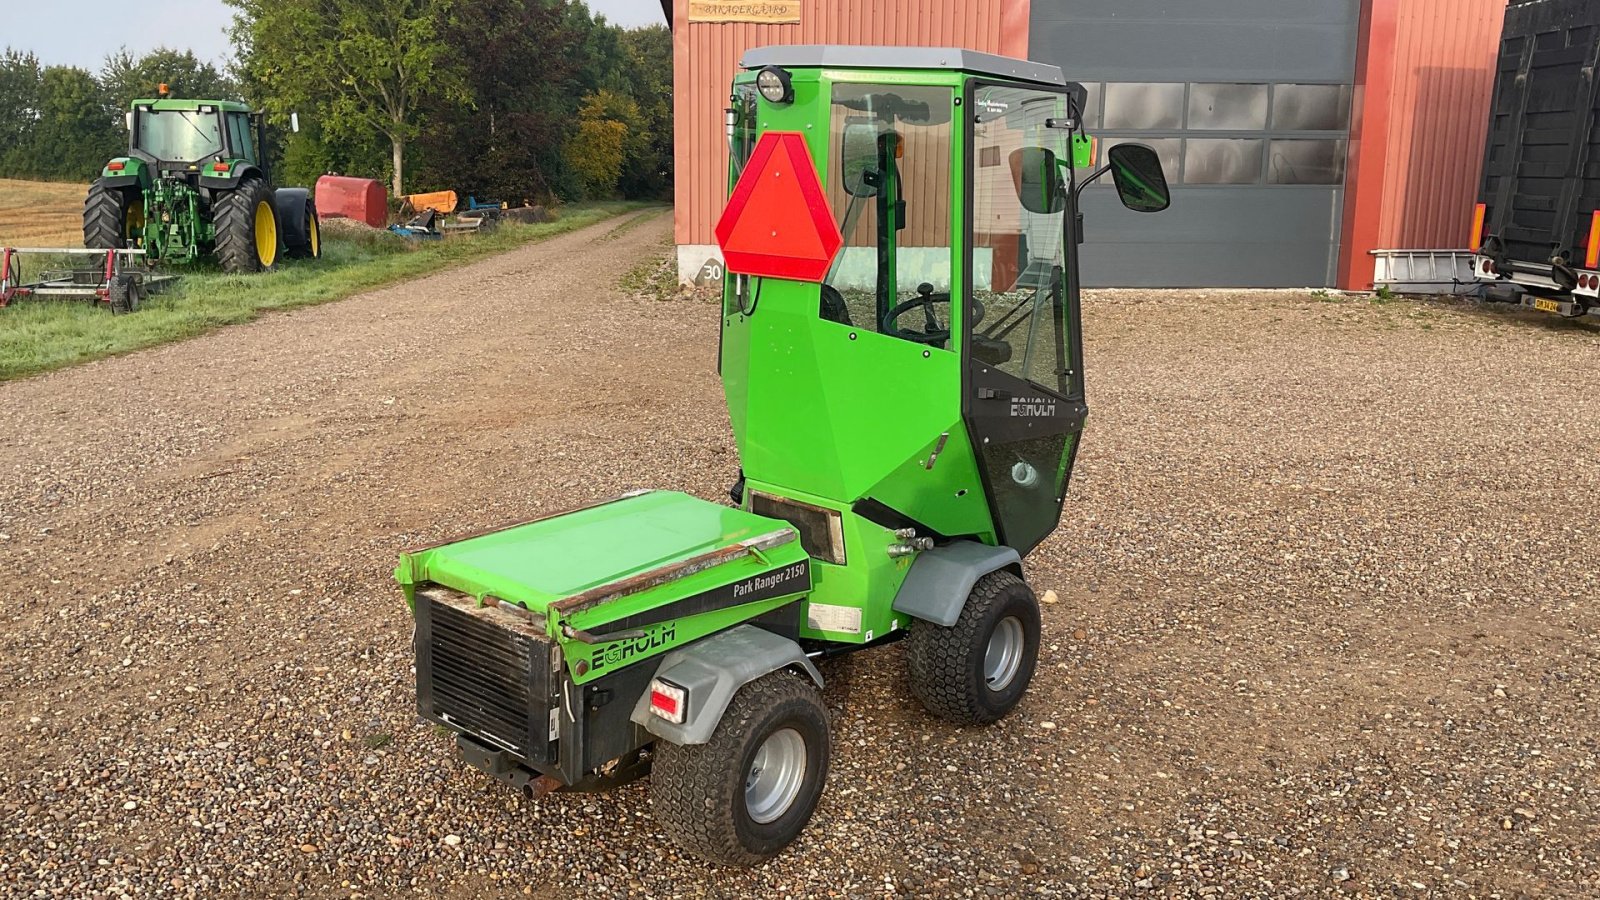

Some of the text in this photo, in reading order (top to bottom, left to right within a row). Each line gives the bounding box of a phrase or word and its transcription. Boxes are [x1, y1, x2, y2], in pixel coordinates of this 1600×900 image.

[703, 264, 721, 280] 30
[1010, 397, 1056, 417] EGHOLM
[733, 563, 805, 598] Park Ranger 2150
[591, 622, 676, 671] EGHOLM
